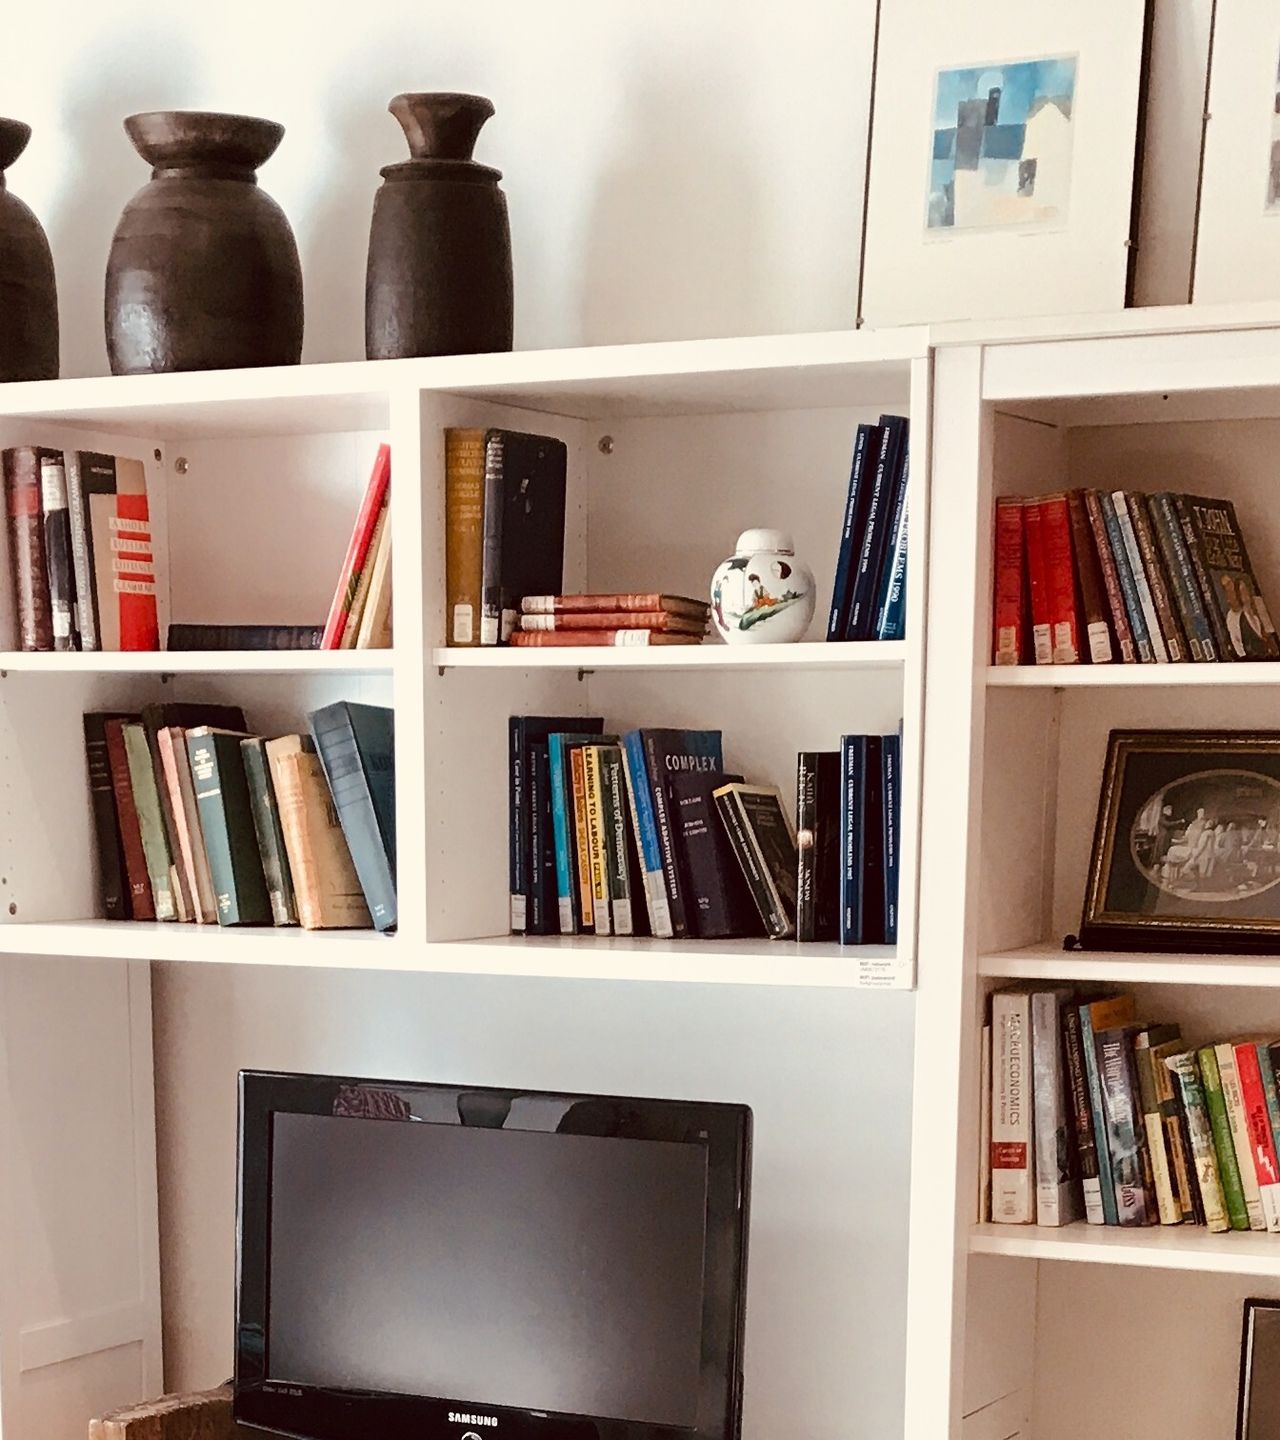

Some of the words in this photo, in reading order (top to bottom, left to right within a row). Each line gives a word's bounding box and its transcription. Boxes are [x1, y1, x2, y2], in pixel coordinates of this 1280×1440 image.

[872, 463, 884, 497] CURRENT
[868, 497, 878, 520] LEGAL
[862, 520, 875, 558] PROBLEMS
[890, 581, 901, 603] 1990
[584, 746, 595, 799] LEARNING
[666, 754, 716, 771] COMPLEX
[609, 762, 621, 808] Patterns
[588, 801, 596, 815] TO
[612, 809, 622, 822] of
[589, 817, 599, 859] LABOUR
[613, 823, 626, 881] Democracy
[653, 786, 666, 823] COMPLEX
[660, 824, 672, 863] ADAPTIVE
[666, 864, 678, 899] SYSTEMS
[1008, 1012, 1021, 1125] MACROECONOMICS
[448, 1412, 498, 1427] SAMSUNG
